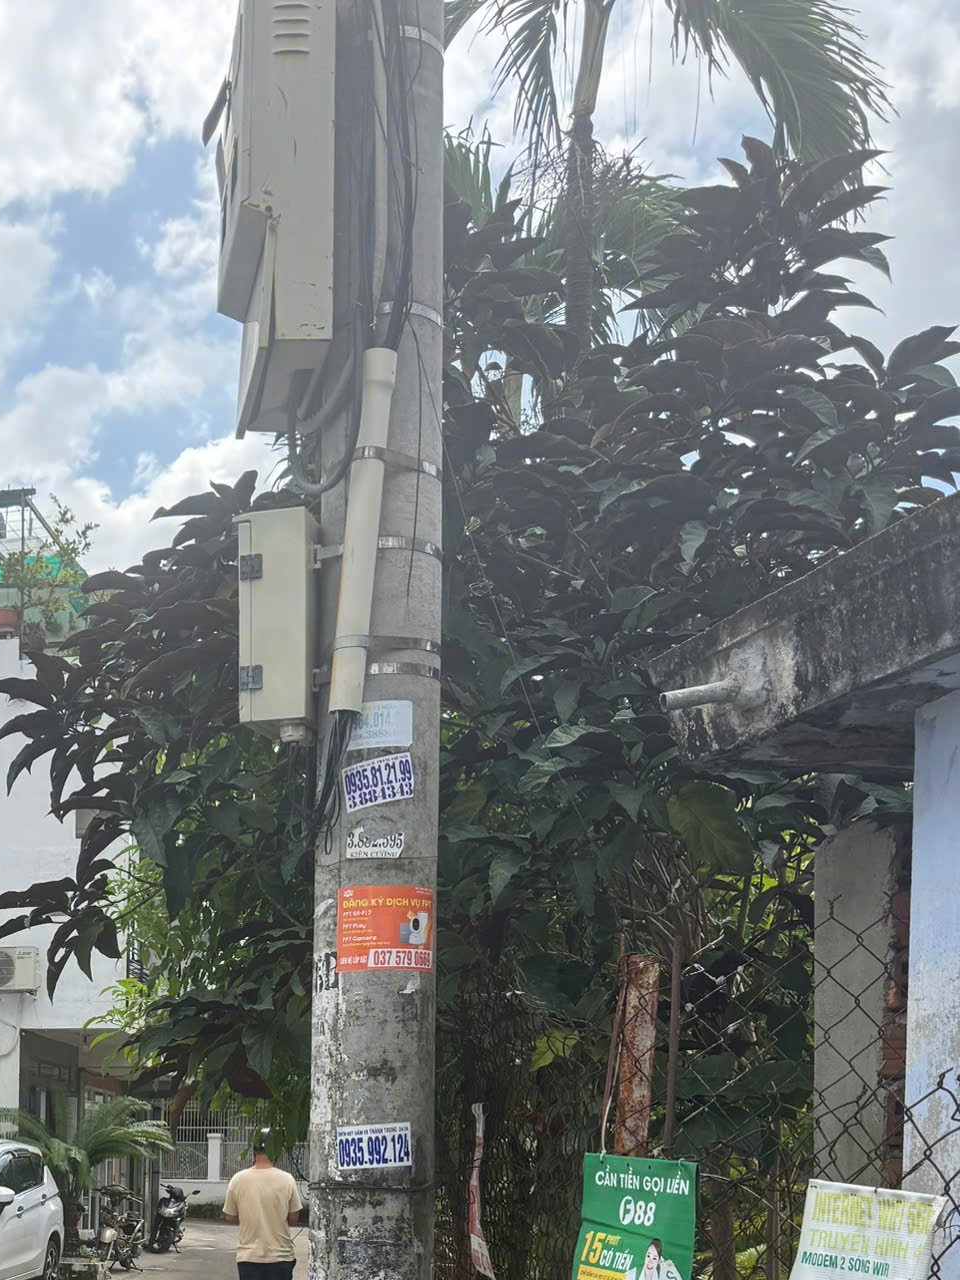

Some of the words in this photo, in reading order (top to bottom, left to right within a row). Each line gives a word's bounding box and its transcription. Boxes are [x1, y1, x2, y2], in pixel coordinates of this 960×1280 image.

[344, 759, 412, 796] 0935.81.21.99
[349, 782, 413, 809] 3.884343
[343, 897, 369, 908] ĐĂNG
[371, 895, 385, 907] KÝ
[386, 897, 409, 908] DỊCH
[410, 898, 420, 909] VỤ
[373, 951, 393, 966] 037
[395, 951, 412, 966] 579
[339, 1133, 410, 1167] 0935.992.124
[595, 1165, 617, 1187] CẦN
[619, 1167, 640, 1190] TIỀN
[643, 1176, 664, 1196] GỌI
[666, 1170, 690, 1195] LIỀN
[619, 1195, 656, 1227] F88
[811, 1191, 873, 1228] INTERNET
[581, 1231, 606, 1264] 15
[599, 1247, 614, 1267] CÓ
[801, 1251, 838, 1269] MODEM
[840, 1256, 846, 1270] 2
